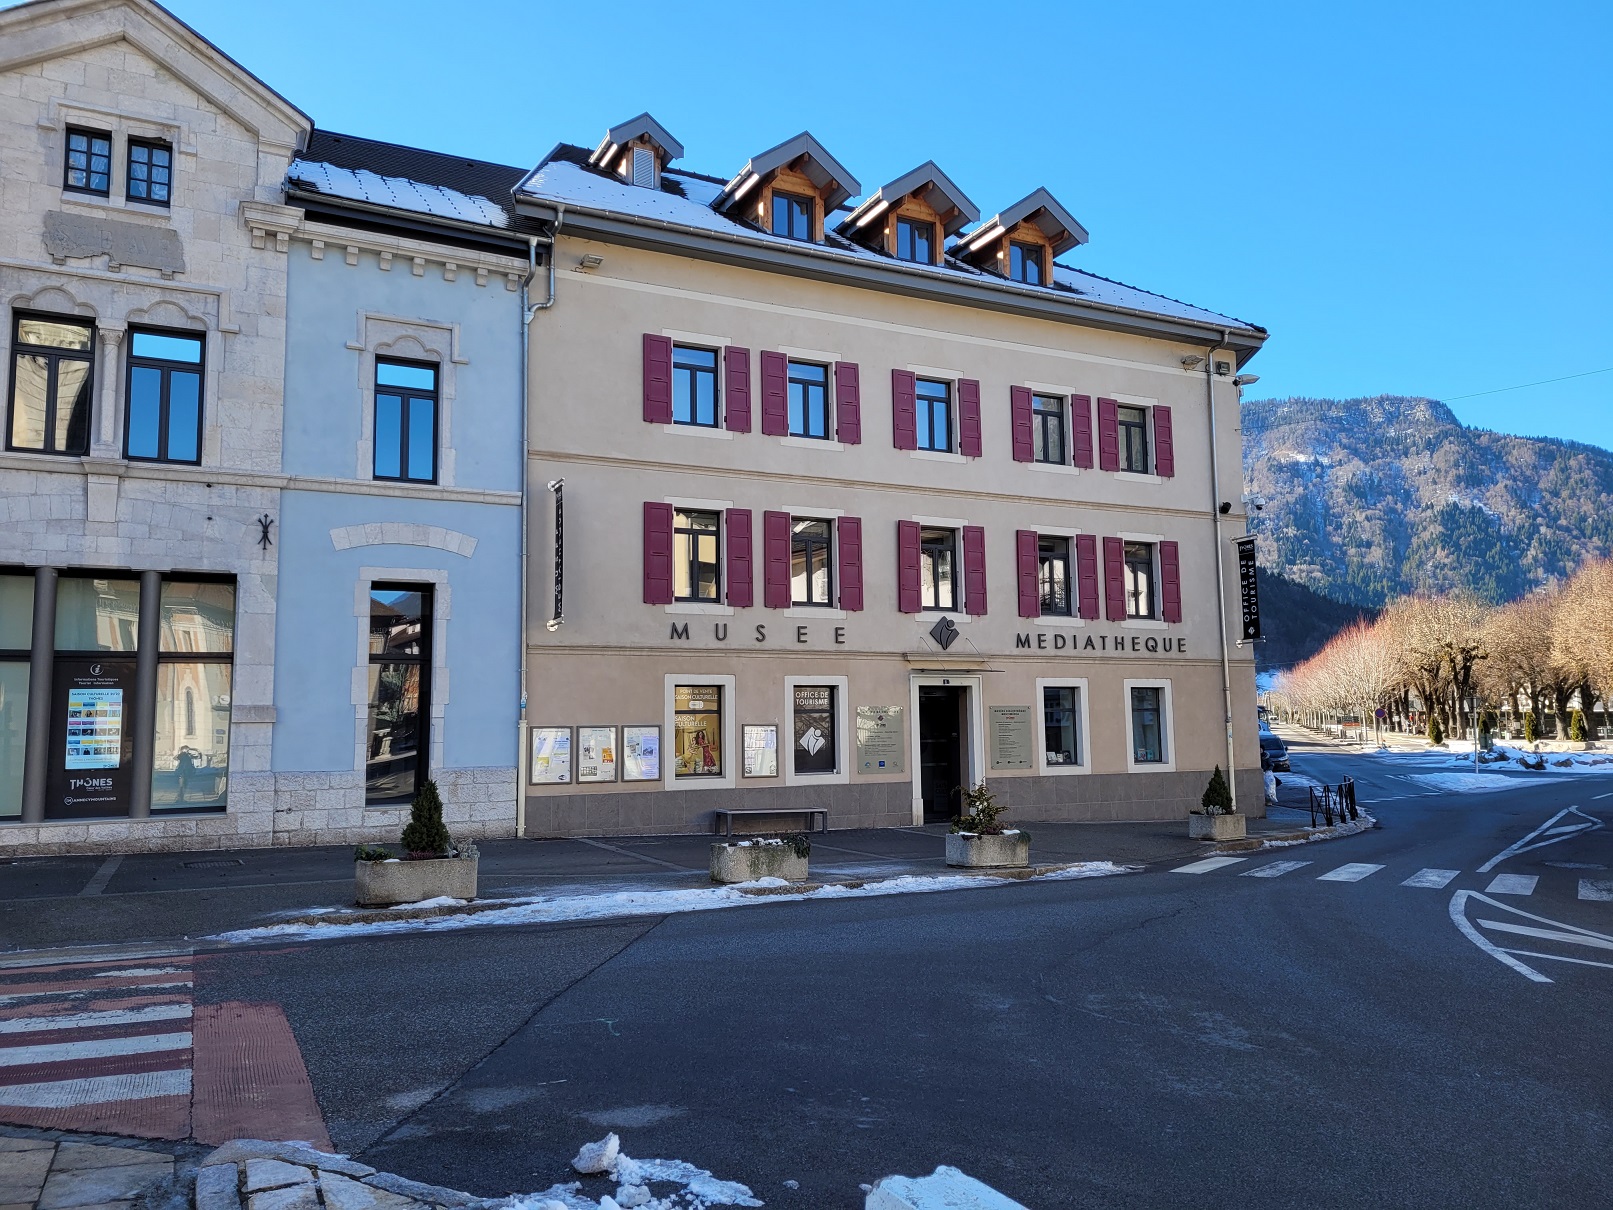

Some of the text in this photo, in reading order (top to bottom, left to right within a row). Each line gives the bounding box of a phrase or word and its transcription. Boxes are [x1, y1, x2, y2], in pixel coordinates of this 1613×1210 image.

[1241, 560, 1250, 622] OFFICE DE
[1248, 560, 1257, 620] TOURISME
[670, 621, 846, 645] MUSEE
[1016, 632, 1187, 653] MEDIATHEQUE
[795, 691, 829, 699] OFFICE DE
[795, 698, 829, 706] TOURISME
[70, 777, 113, 790] THÔNES
